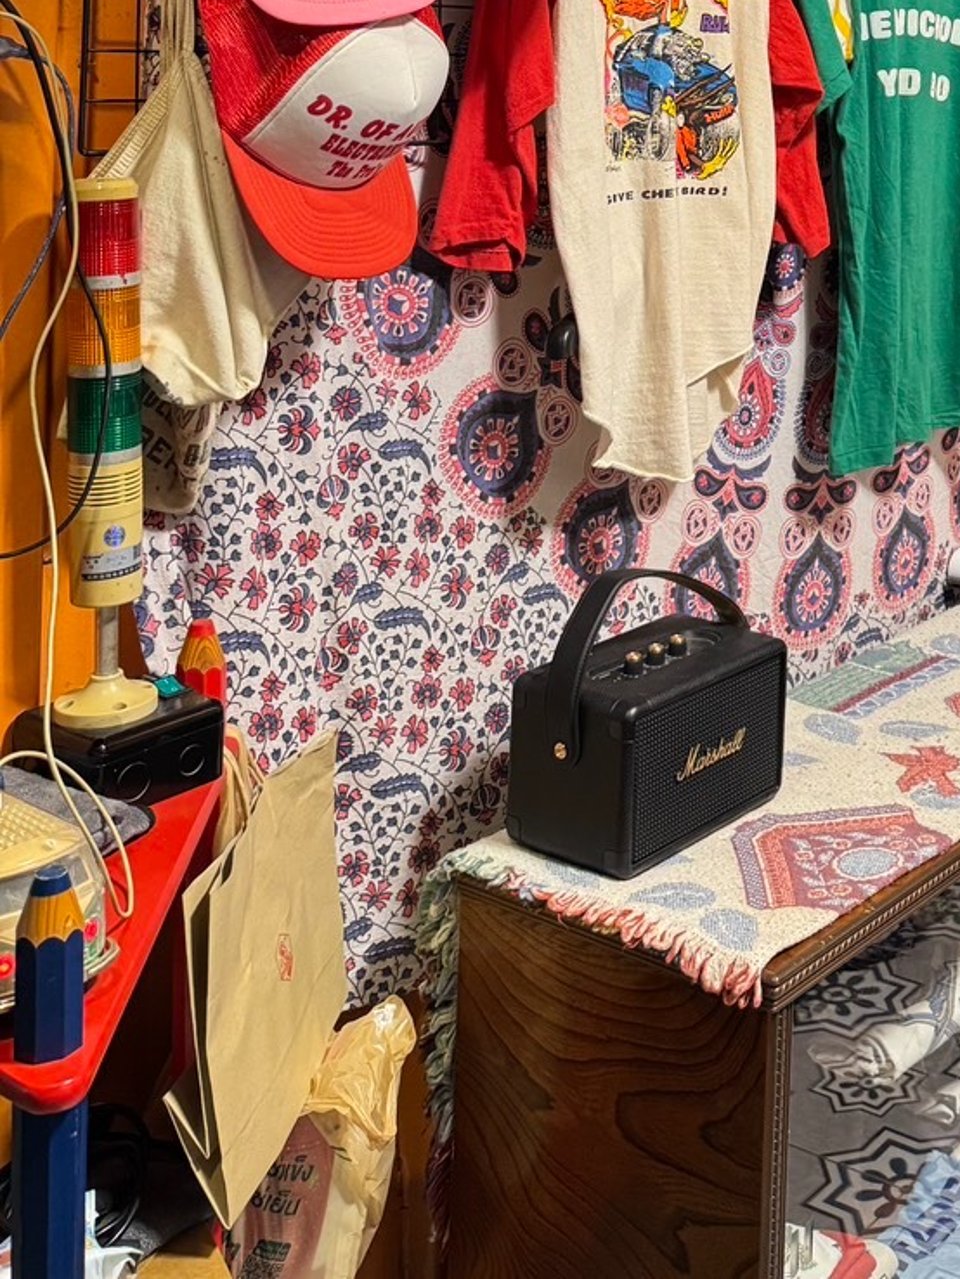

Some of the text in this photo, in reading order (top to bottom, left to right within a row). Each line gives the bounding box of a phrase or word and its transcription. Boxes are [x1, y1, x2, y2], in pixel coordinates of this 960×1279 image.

[306, 93, 353, 131] DR.
[359, 119, 401, 141] OF
[675, 725, 747, 782] Marshall
